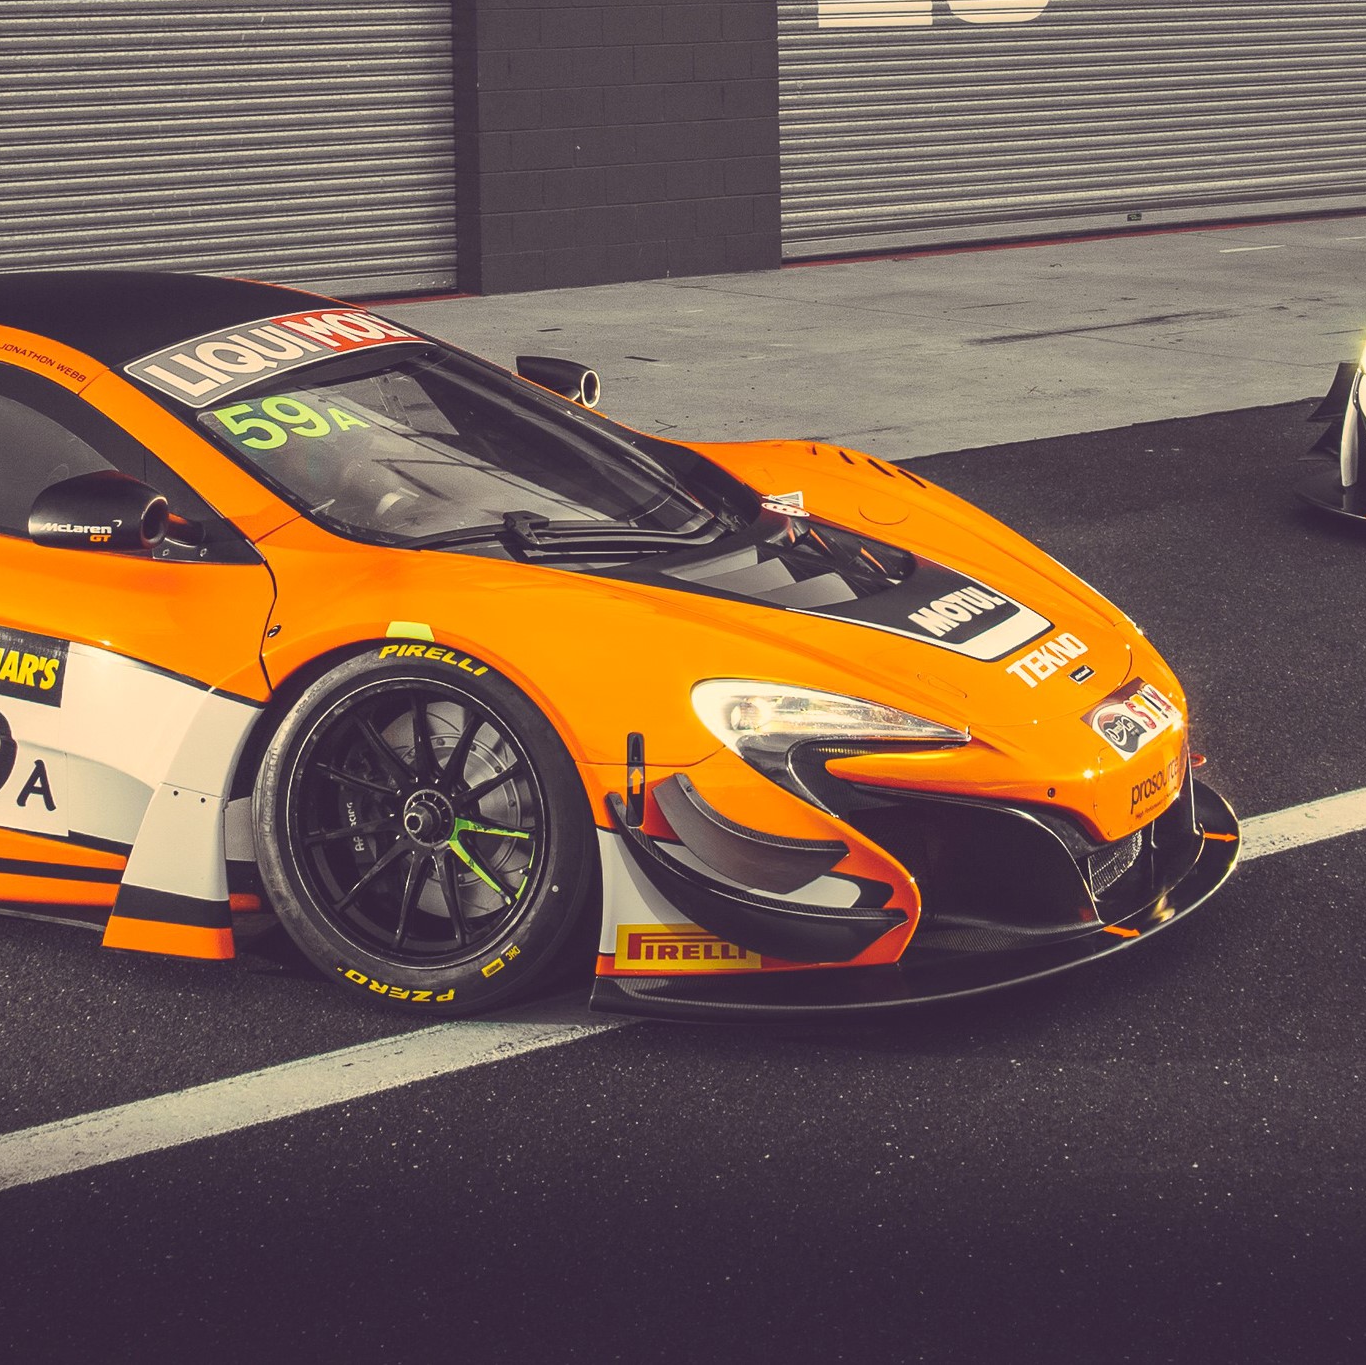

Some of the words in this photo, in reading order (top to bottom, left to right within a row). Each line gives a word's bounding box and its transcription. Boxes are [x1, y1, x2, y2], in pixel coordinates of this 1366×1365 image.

[56, 363, 87, 383] WEBB
[143, 324, 322, 398] LIQUI
[40, 521, 115, 534] McLaren
[89, 535, 111, 543] GT
[908, 586, 1007, 637] MOTUL
[378, 643, 488, 677] PIRELLI
[1006, 632, 1088, 688] TEKNO
[505, 945, 521, 961] DHC
[627, 933, 747, 960] PIRELLI
